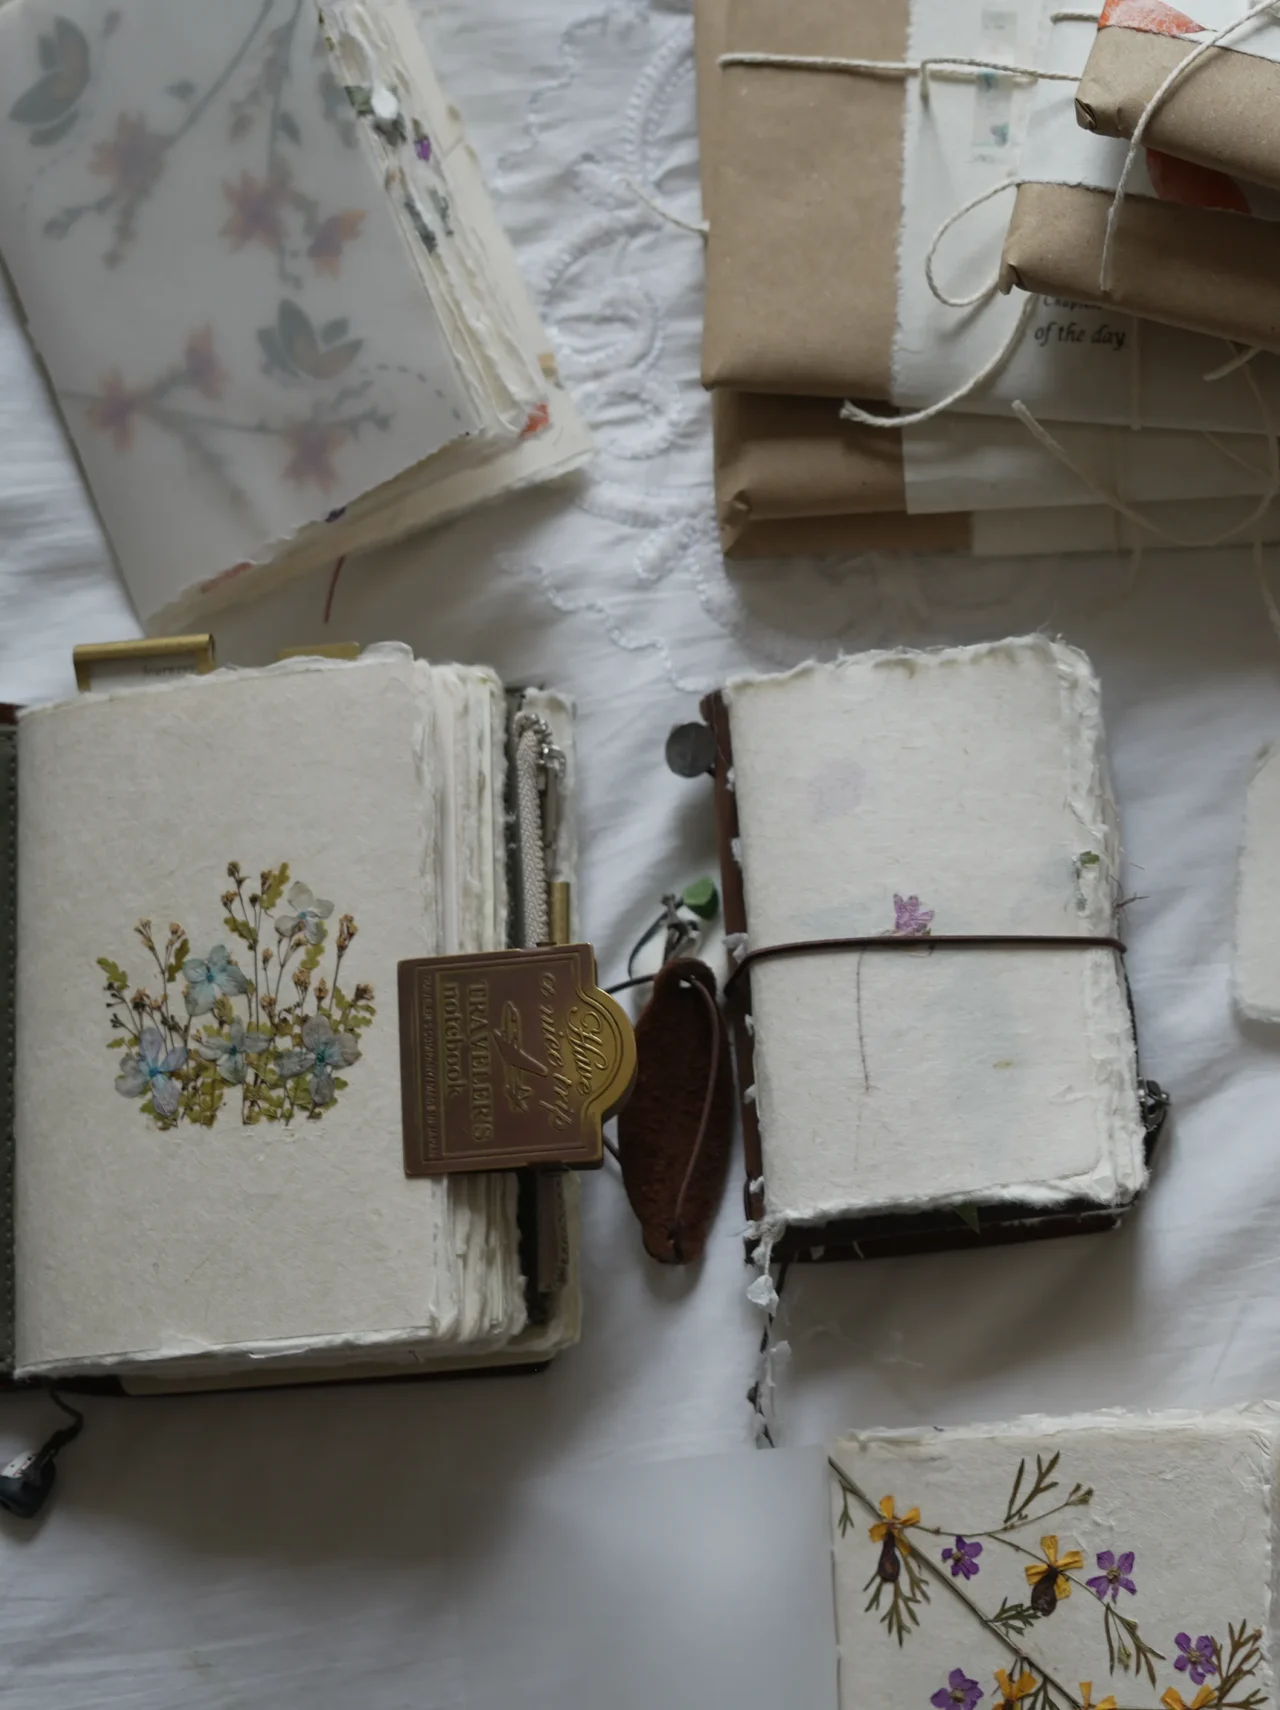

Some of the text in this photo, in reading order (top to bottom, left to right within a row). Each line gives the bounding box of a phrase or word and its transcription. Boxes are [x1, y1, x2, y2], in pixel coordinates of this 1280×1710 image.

[1034, 321, 1126, 350] of the day
[443, 982, 467, 1097] notebook
[539, 972, 576, 1132] a nice trip
[567, 1006, 609, 1096] Have
